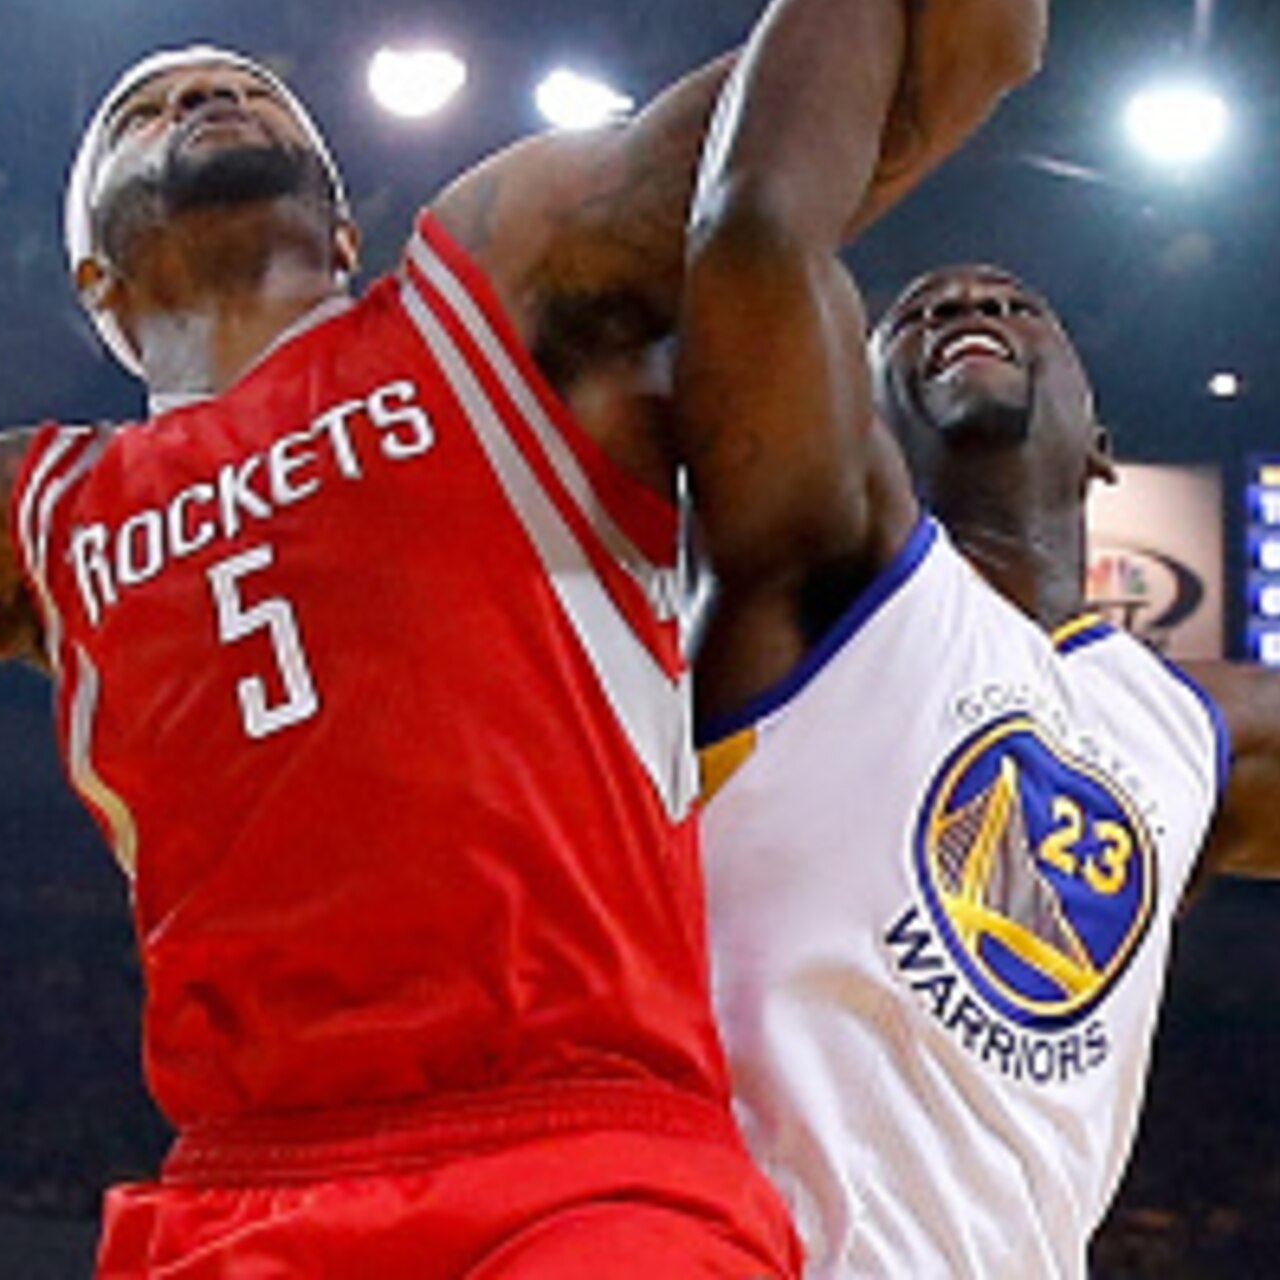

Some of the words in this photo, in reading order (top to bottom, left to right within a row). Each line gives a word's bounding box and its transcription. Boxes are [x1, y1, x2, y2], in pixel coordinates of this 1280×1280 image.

[71, 380, 436, 627] ROCKETS
[207, 544, 319, 740] 5
[1038, 795, 1133, 894] 23
[885, 907, 1110, 1083] WARRIORS
